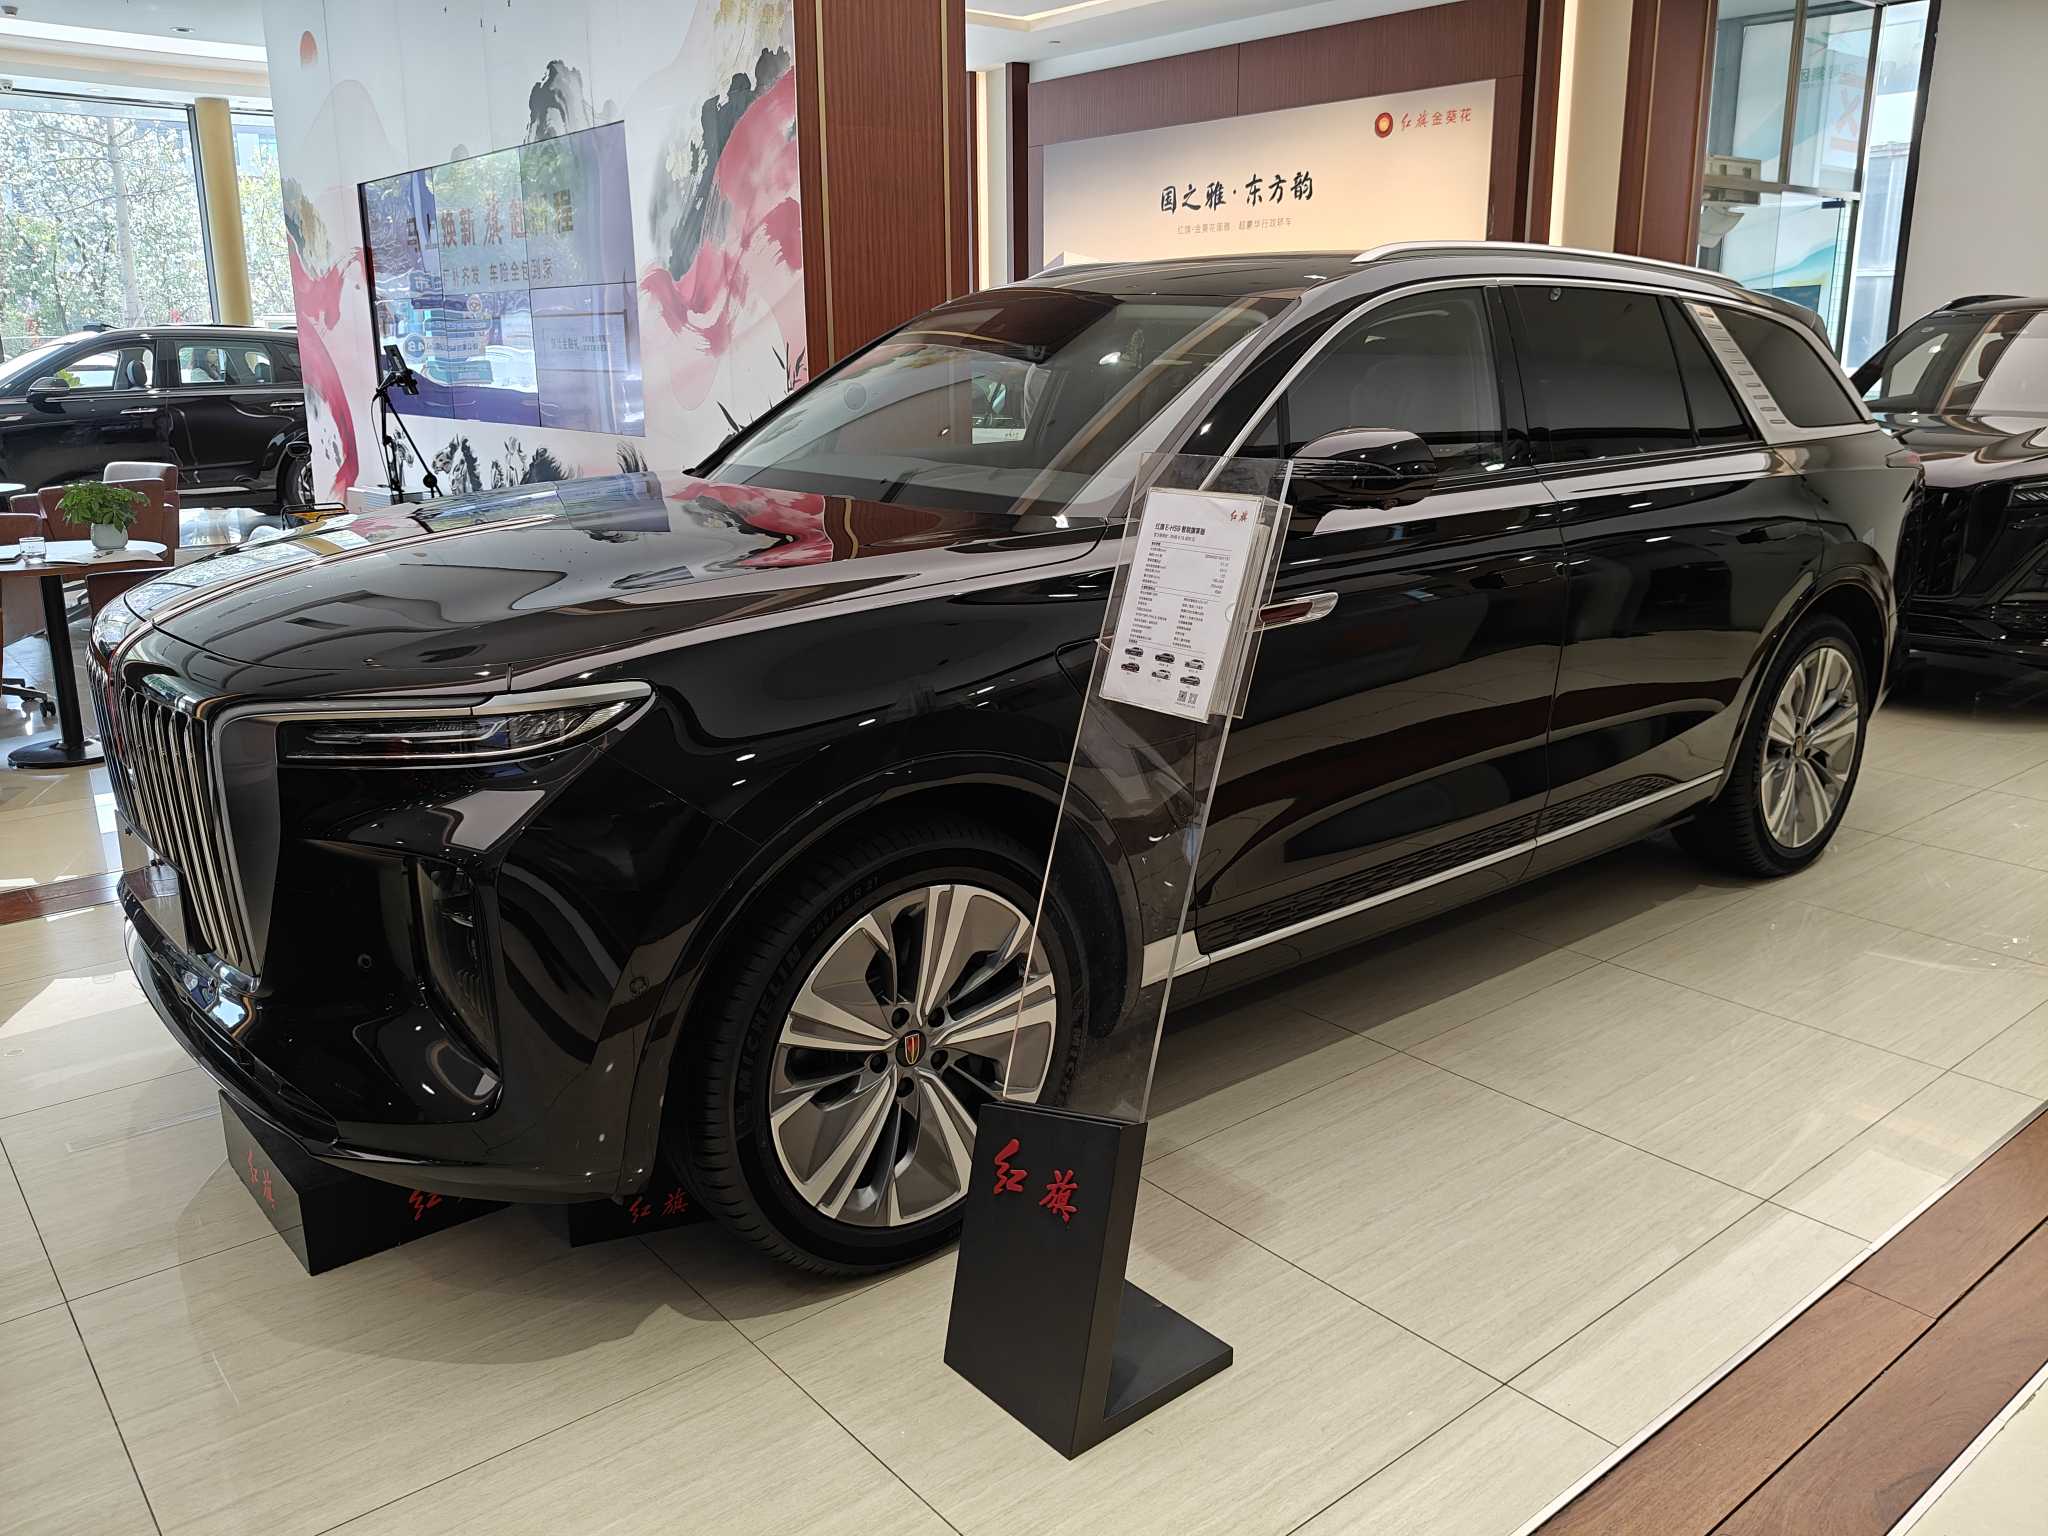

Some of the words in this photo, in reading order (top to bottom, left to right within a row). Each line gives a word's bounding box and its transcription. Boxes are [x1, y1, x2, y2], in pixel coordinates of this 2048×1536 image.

[1401, 107, 1472, 130] 红旗金葵花
[1161, 170, 1313, 215] 国之雅·东方韵
[993, 1138, 1079, 1224] 红旗
